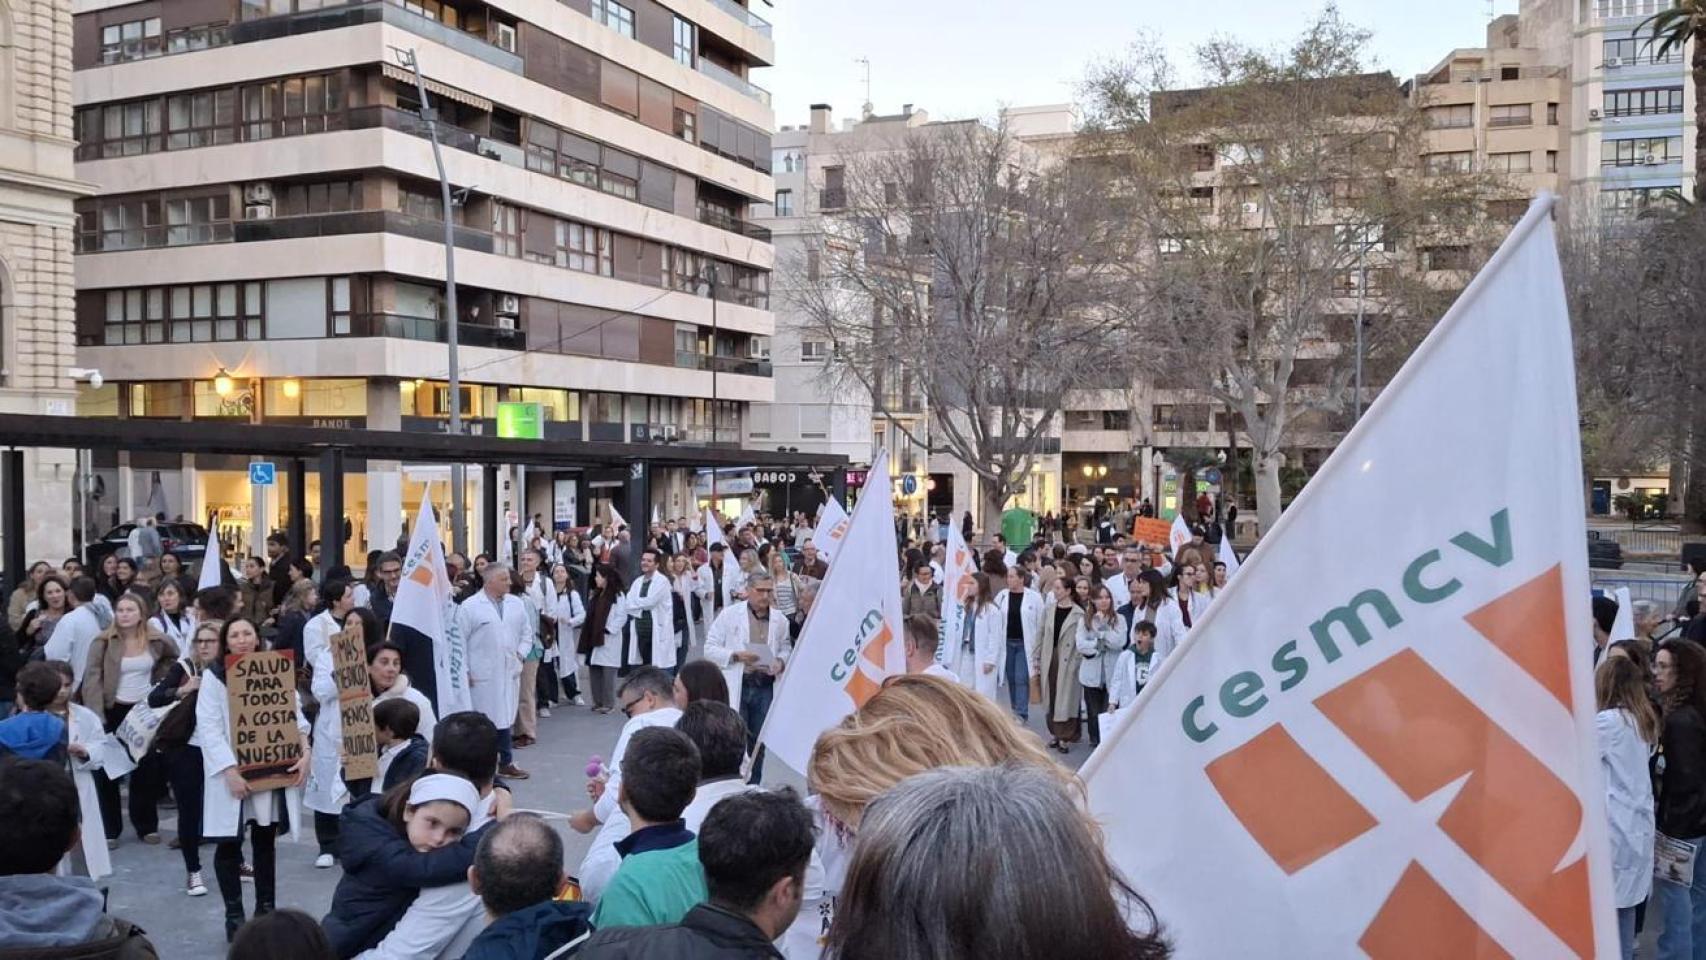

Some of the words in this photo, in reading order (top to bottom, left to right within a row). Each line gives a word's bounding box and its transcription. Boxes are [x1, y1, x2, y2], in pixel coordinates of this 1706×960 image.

[754, 471, 796, 483] BABOO
[1181, 507, 1514, 743] cesmcv
[235, 658, 290, 677] SALUD
[245, 676, 282, 691] PARA
[239, 691, 288, 706] TODOS
[237, 714, 247, 727] A
[253, 710, 298, 726] COSTA
[237, 731, 256, 745] DE
[267, 730, 285, 743] LA
[236, 743, 303, 765] NUESTRA
